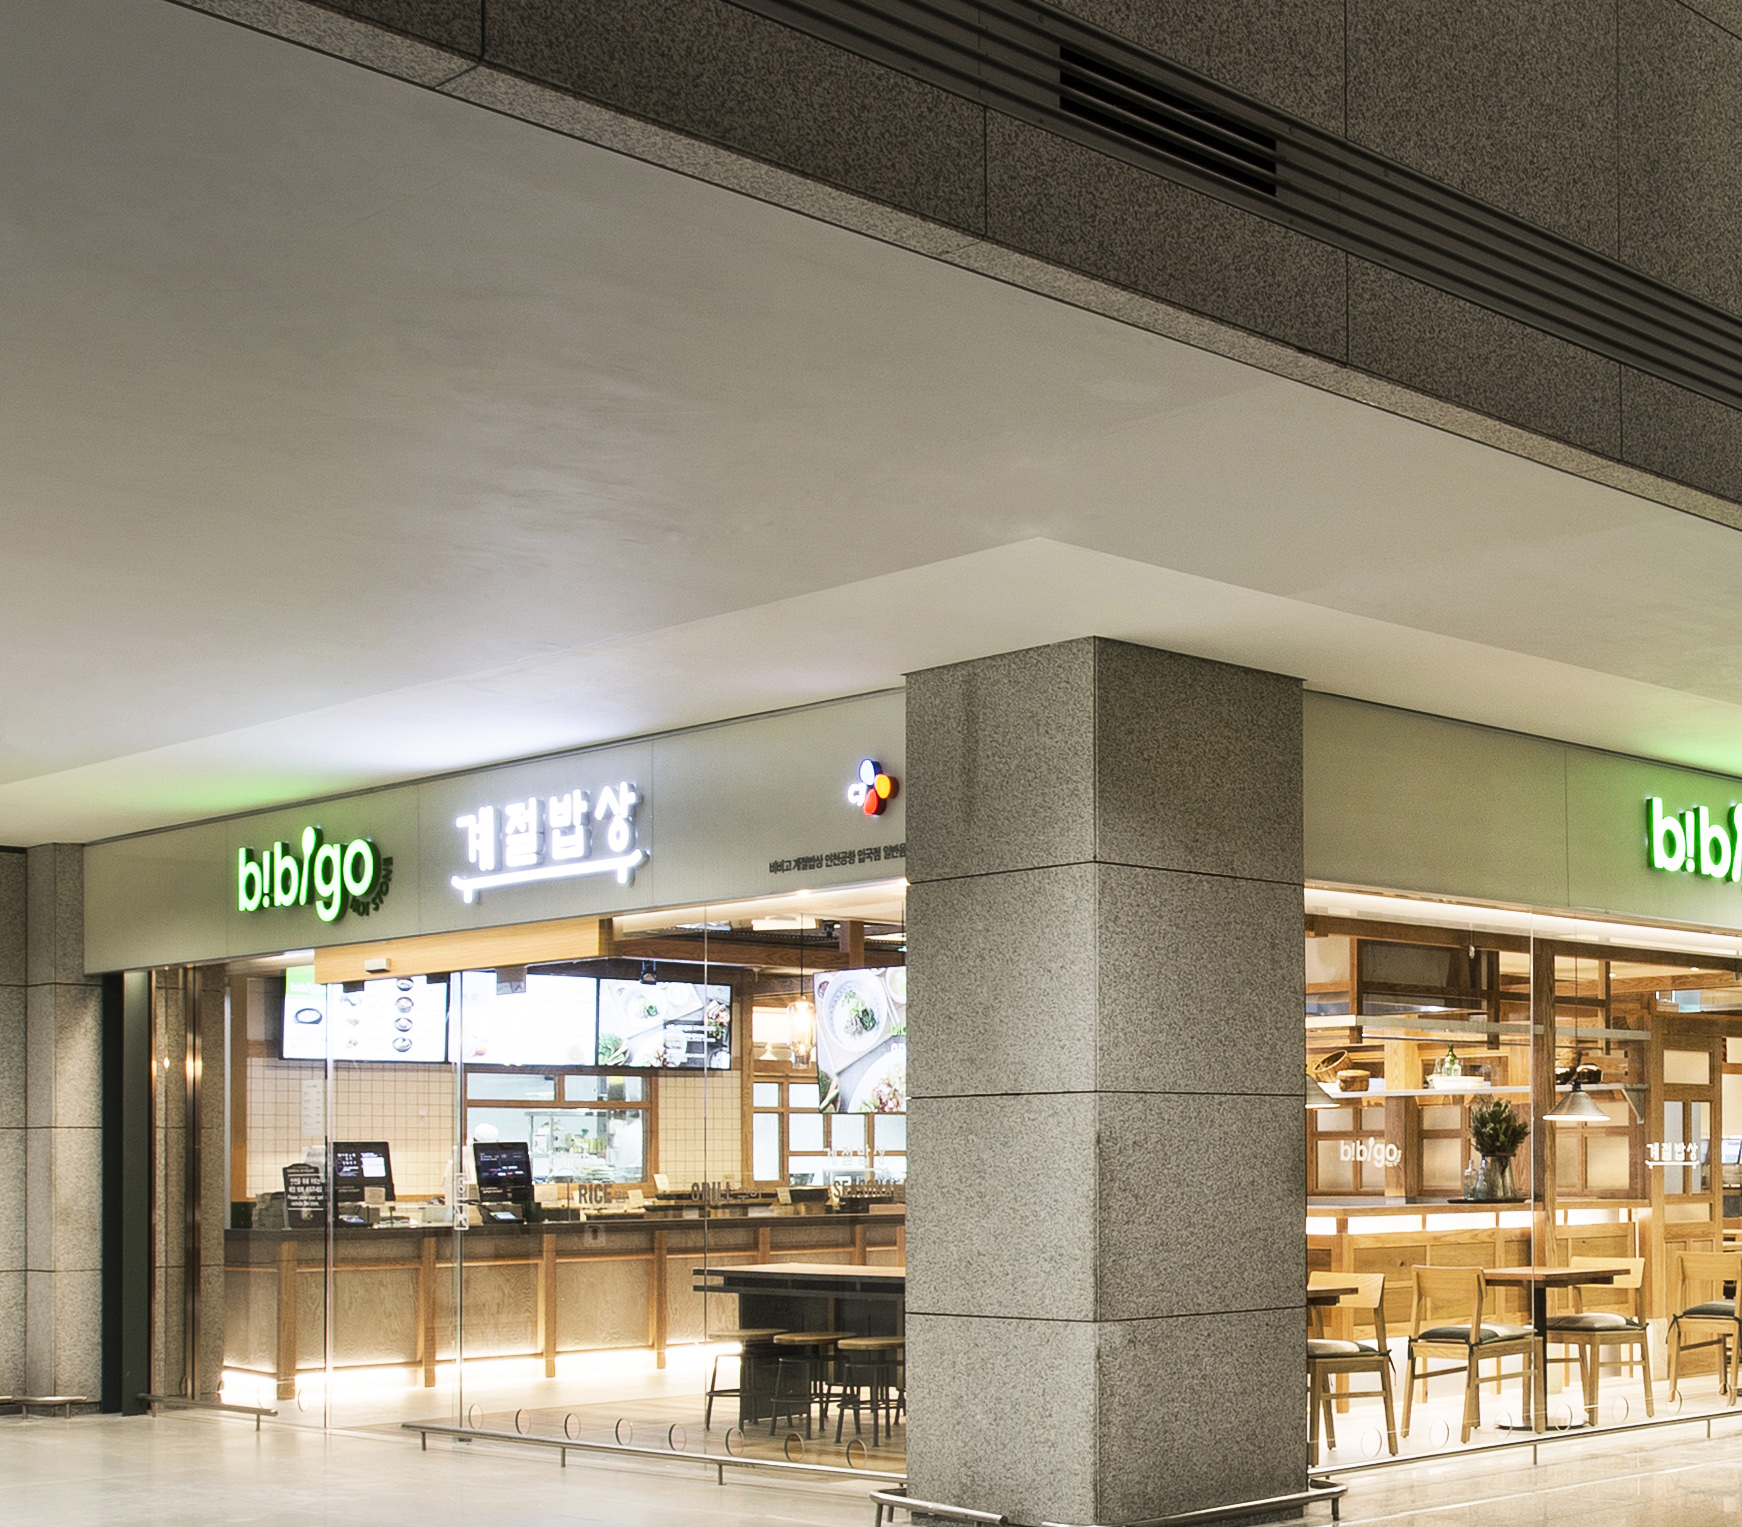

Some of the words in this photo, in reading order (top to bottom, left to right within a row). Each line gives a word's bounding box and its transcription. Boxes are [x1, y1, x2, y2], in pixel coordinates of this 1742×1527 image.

[455, 780, 637, 872] 계절밥상
[768, 859, 792, 875] 비비고
[792, 853, 823, 872] 계절밥상
[824, 849, 856, 868] 인천공항
[857, 845, 881, 864] 입국점
[1646, 1141, 1699, 1162] 계절밥상
[578, 1183, 613, 1205] RICE
